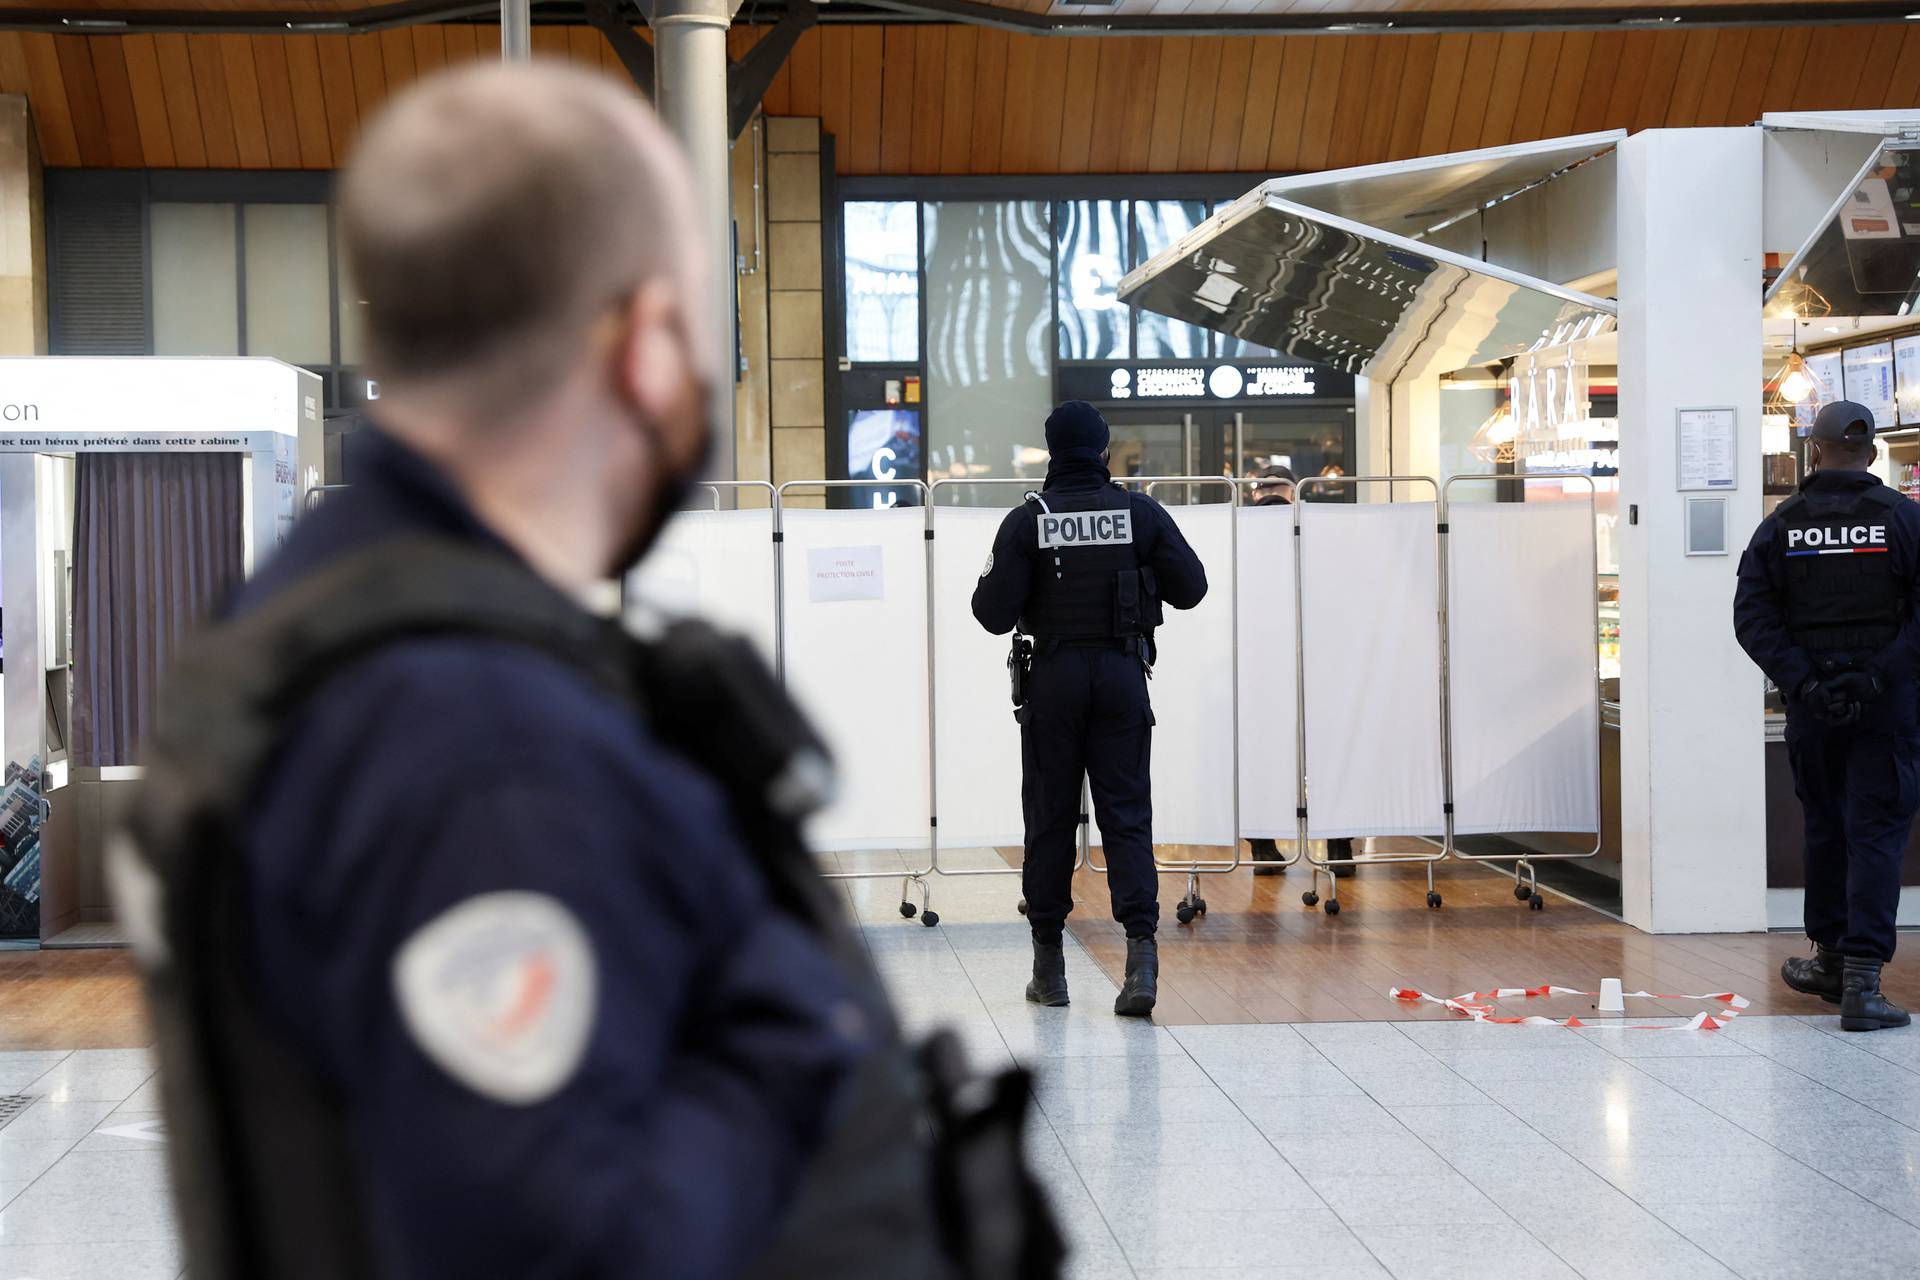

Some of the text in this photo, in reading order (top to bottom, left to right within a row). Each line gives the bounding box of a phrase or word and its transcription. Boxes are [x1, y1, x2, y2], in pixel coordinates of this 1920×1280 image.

[20, 438, 40, 446] ton
[45, 437, 79, 446] héros
[83, 437, 128, 447] préféré
[132, 437, 161, 446] dans
[165, 437, 197, 446] cette
[201, 437, 240, 446] cabine
[1043, 513, 1127, 543] POLICE
[1788, 525, 1885, 548] POLICE
